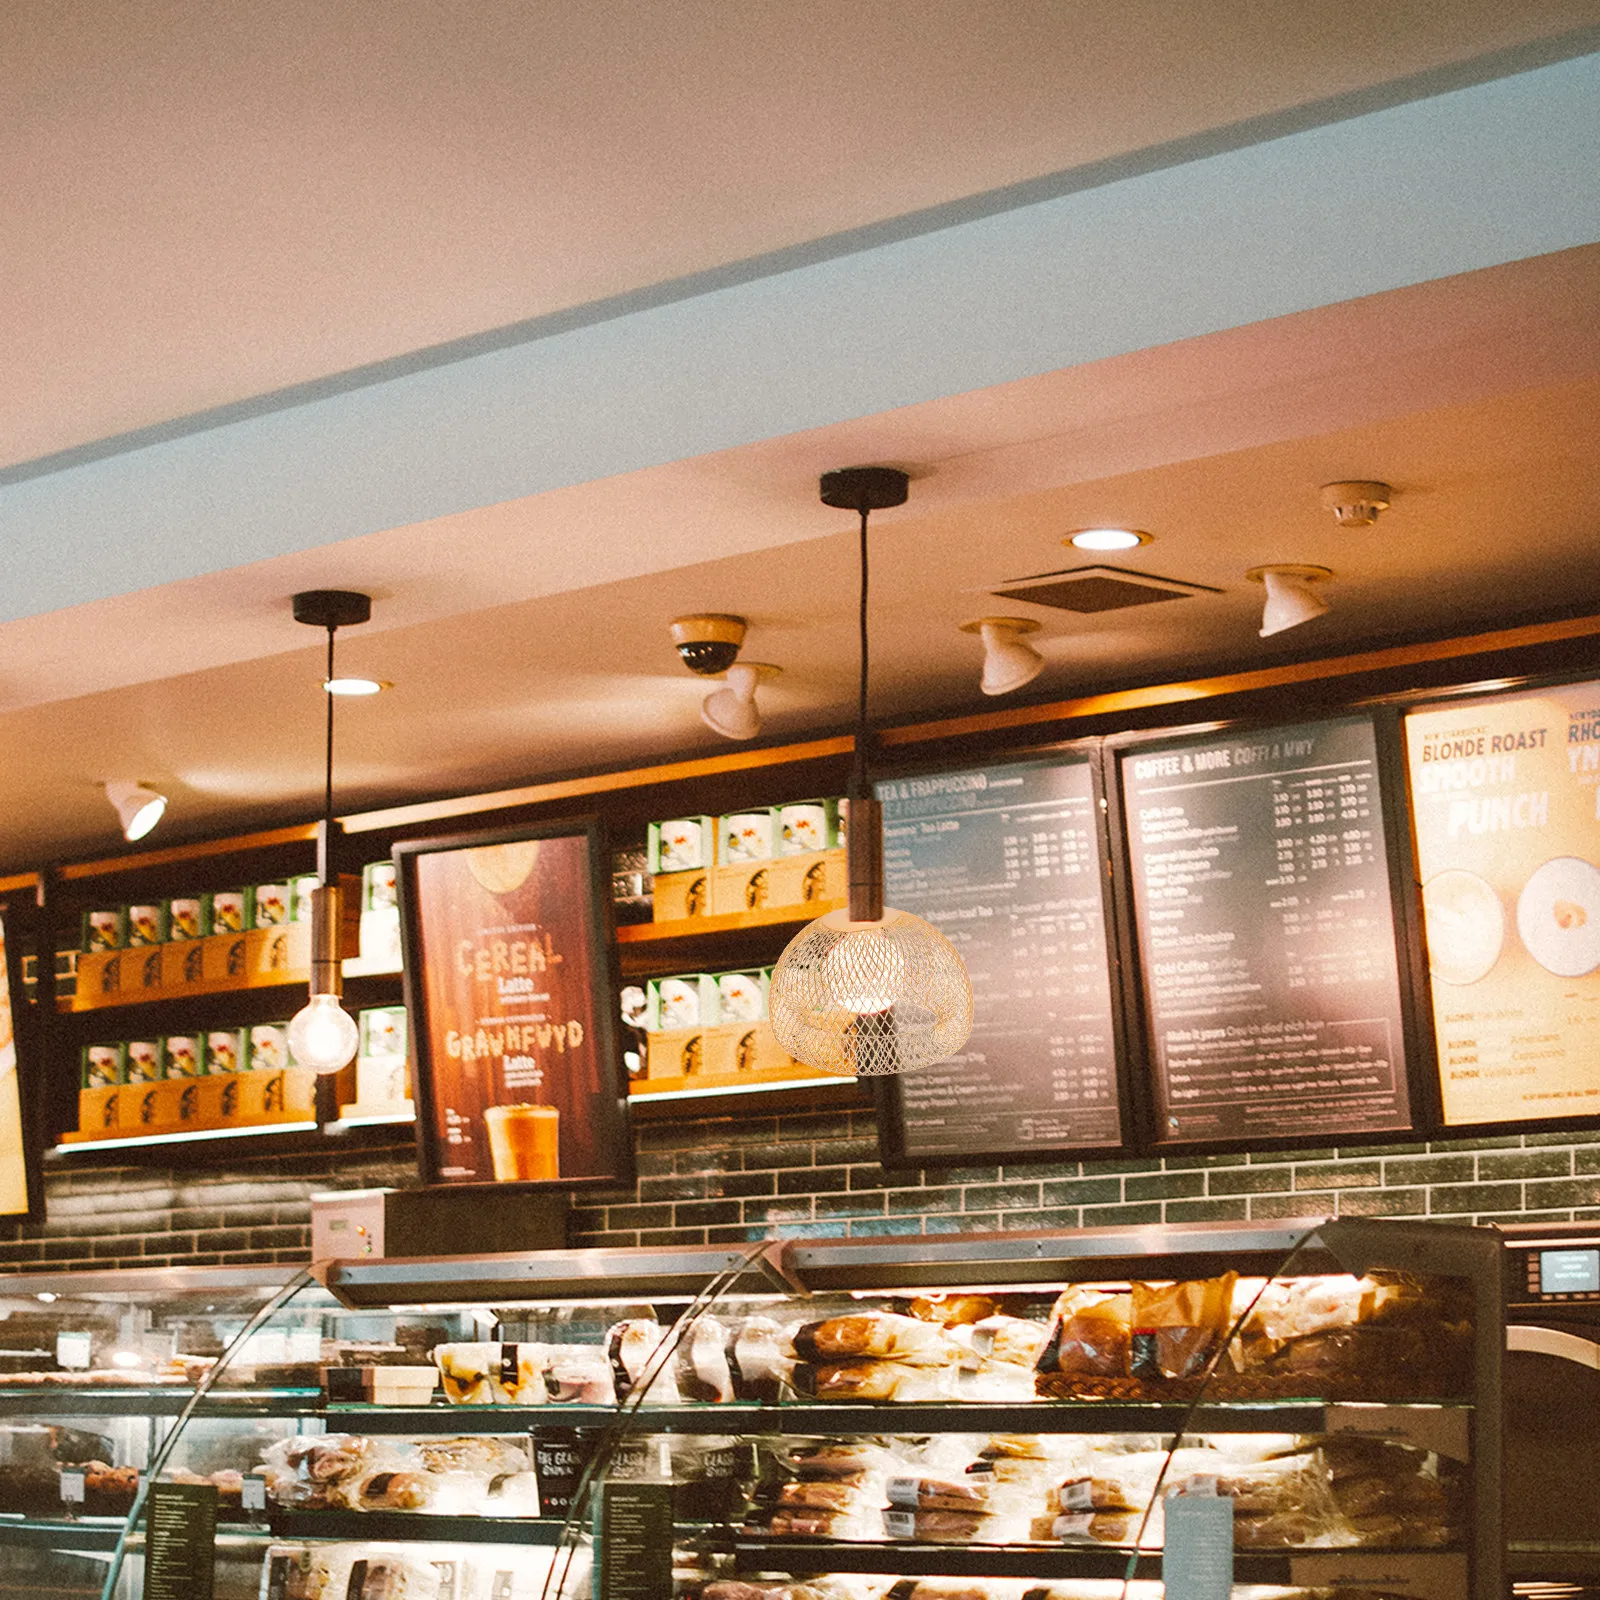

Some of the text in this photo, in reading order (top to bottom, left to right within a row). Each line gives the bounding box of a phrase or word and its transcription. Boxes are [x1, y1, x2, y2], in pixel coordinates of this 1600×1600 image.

[1422, 728, 1548, 763] BLONDE ROAST
[1134, 756, 1180, 780] COFFEE
[1181, 754, 1194, 774] &
[1195, 749, 1231, 771] MORE
[1418, 756, 1516, 793] SMOOTH
[1448, 791, 1549, 837] PUNCH
[456, 932, 563, 982] CEREAL
[497, 976, 535, 994] Latte
[503, 1055, 536, 1071] Latte
